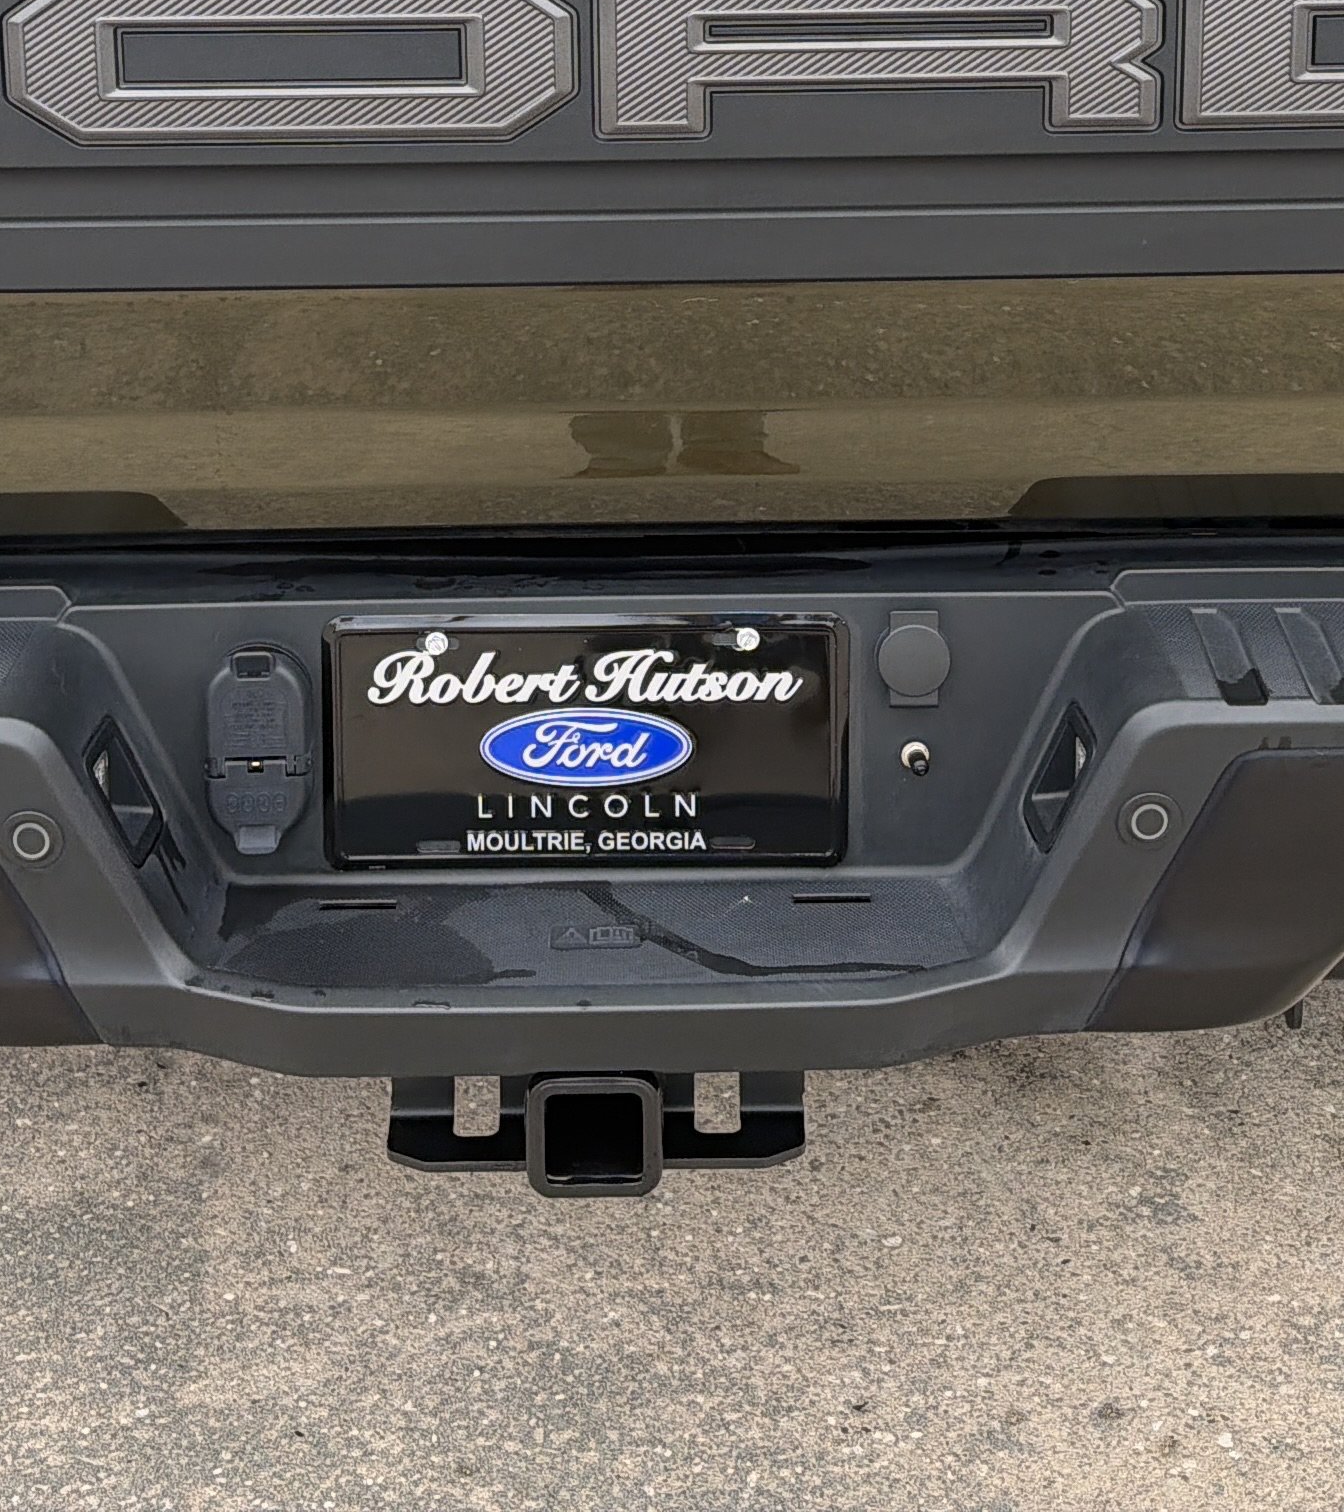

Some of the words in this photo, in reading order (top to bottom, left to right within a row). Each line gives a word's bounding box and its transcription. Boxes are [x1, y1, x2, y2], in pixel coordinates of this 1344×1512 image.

[367, 650, 581, 705] Robert
[584, 648, 804, 703] Hutson
[522, 720, 651, 770] Ford
[477, 794, 698, 819] LINCOLN
[466, 830, 591, 854] MOULTRIE,
[597, 829, 706, 852] GEORGIA
